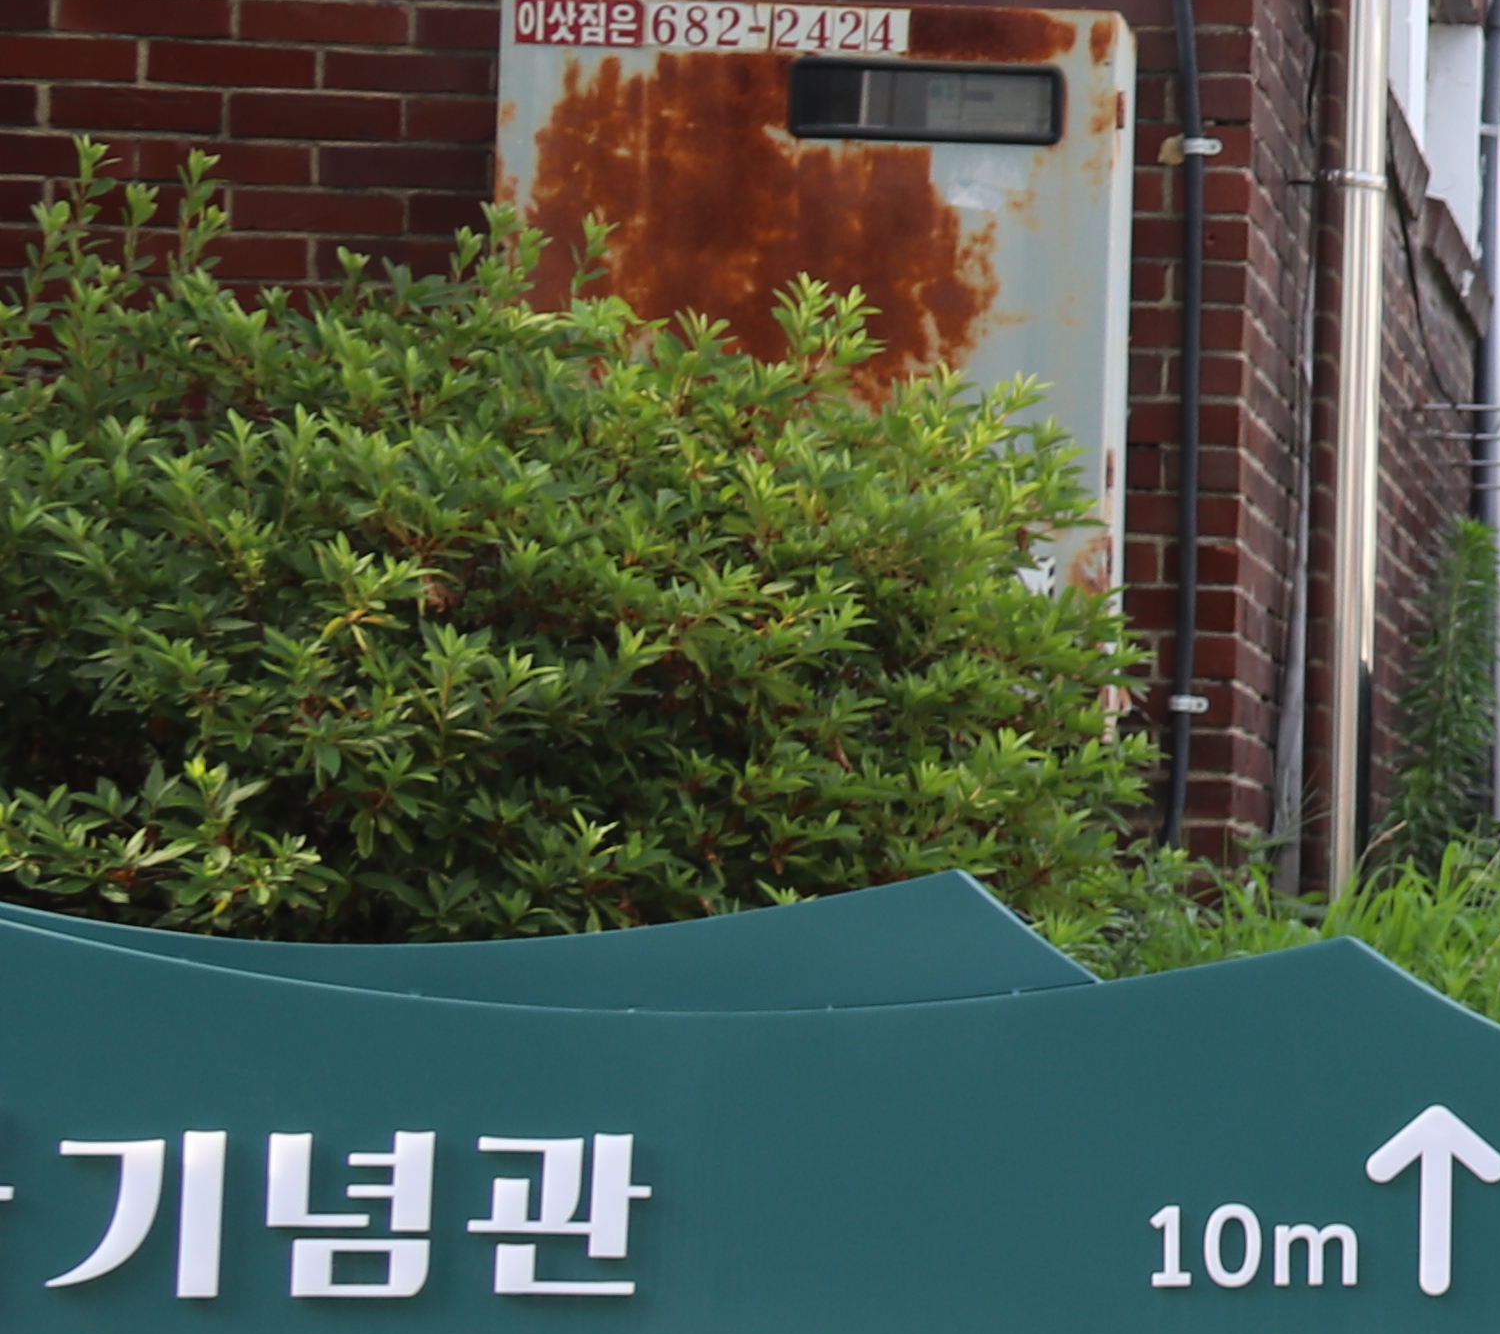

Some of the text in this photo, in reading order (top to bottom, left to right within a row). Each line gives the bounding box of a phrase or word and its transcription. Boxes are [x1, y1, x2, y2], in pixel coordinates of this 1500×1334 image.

[652, 5, 897, 51] 682-2424
[45, 1129, 653, 1299] 기념관
[1148, 1203, 1360, 1288] 10m
